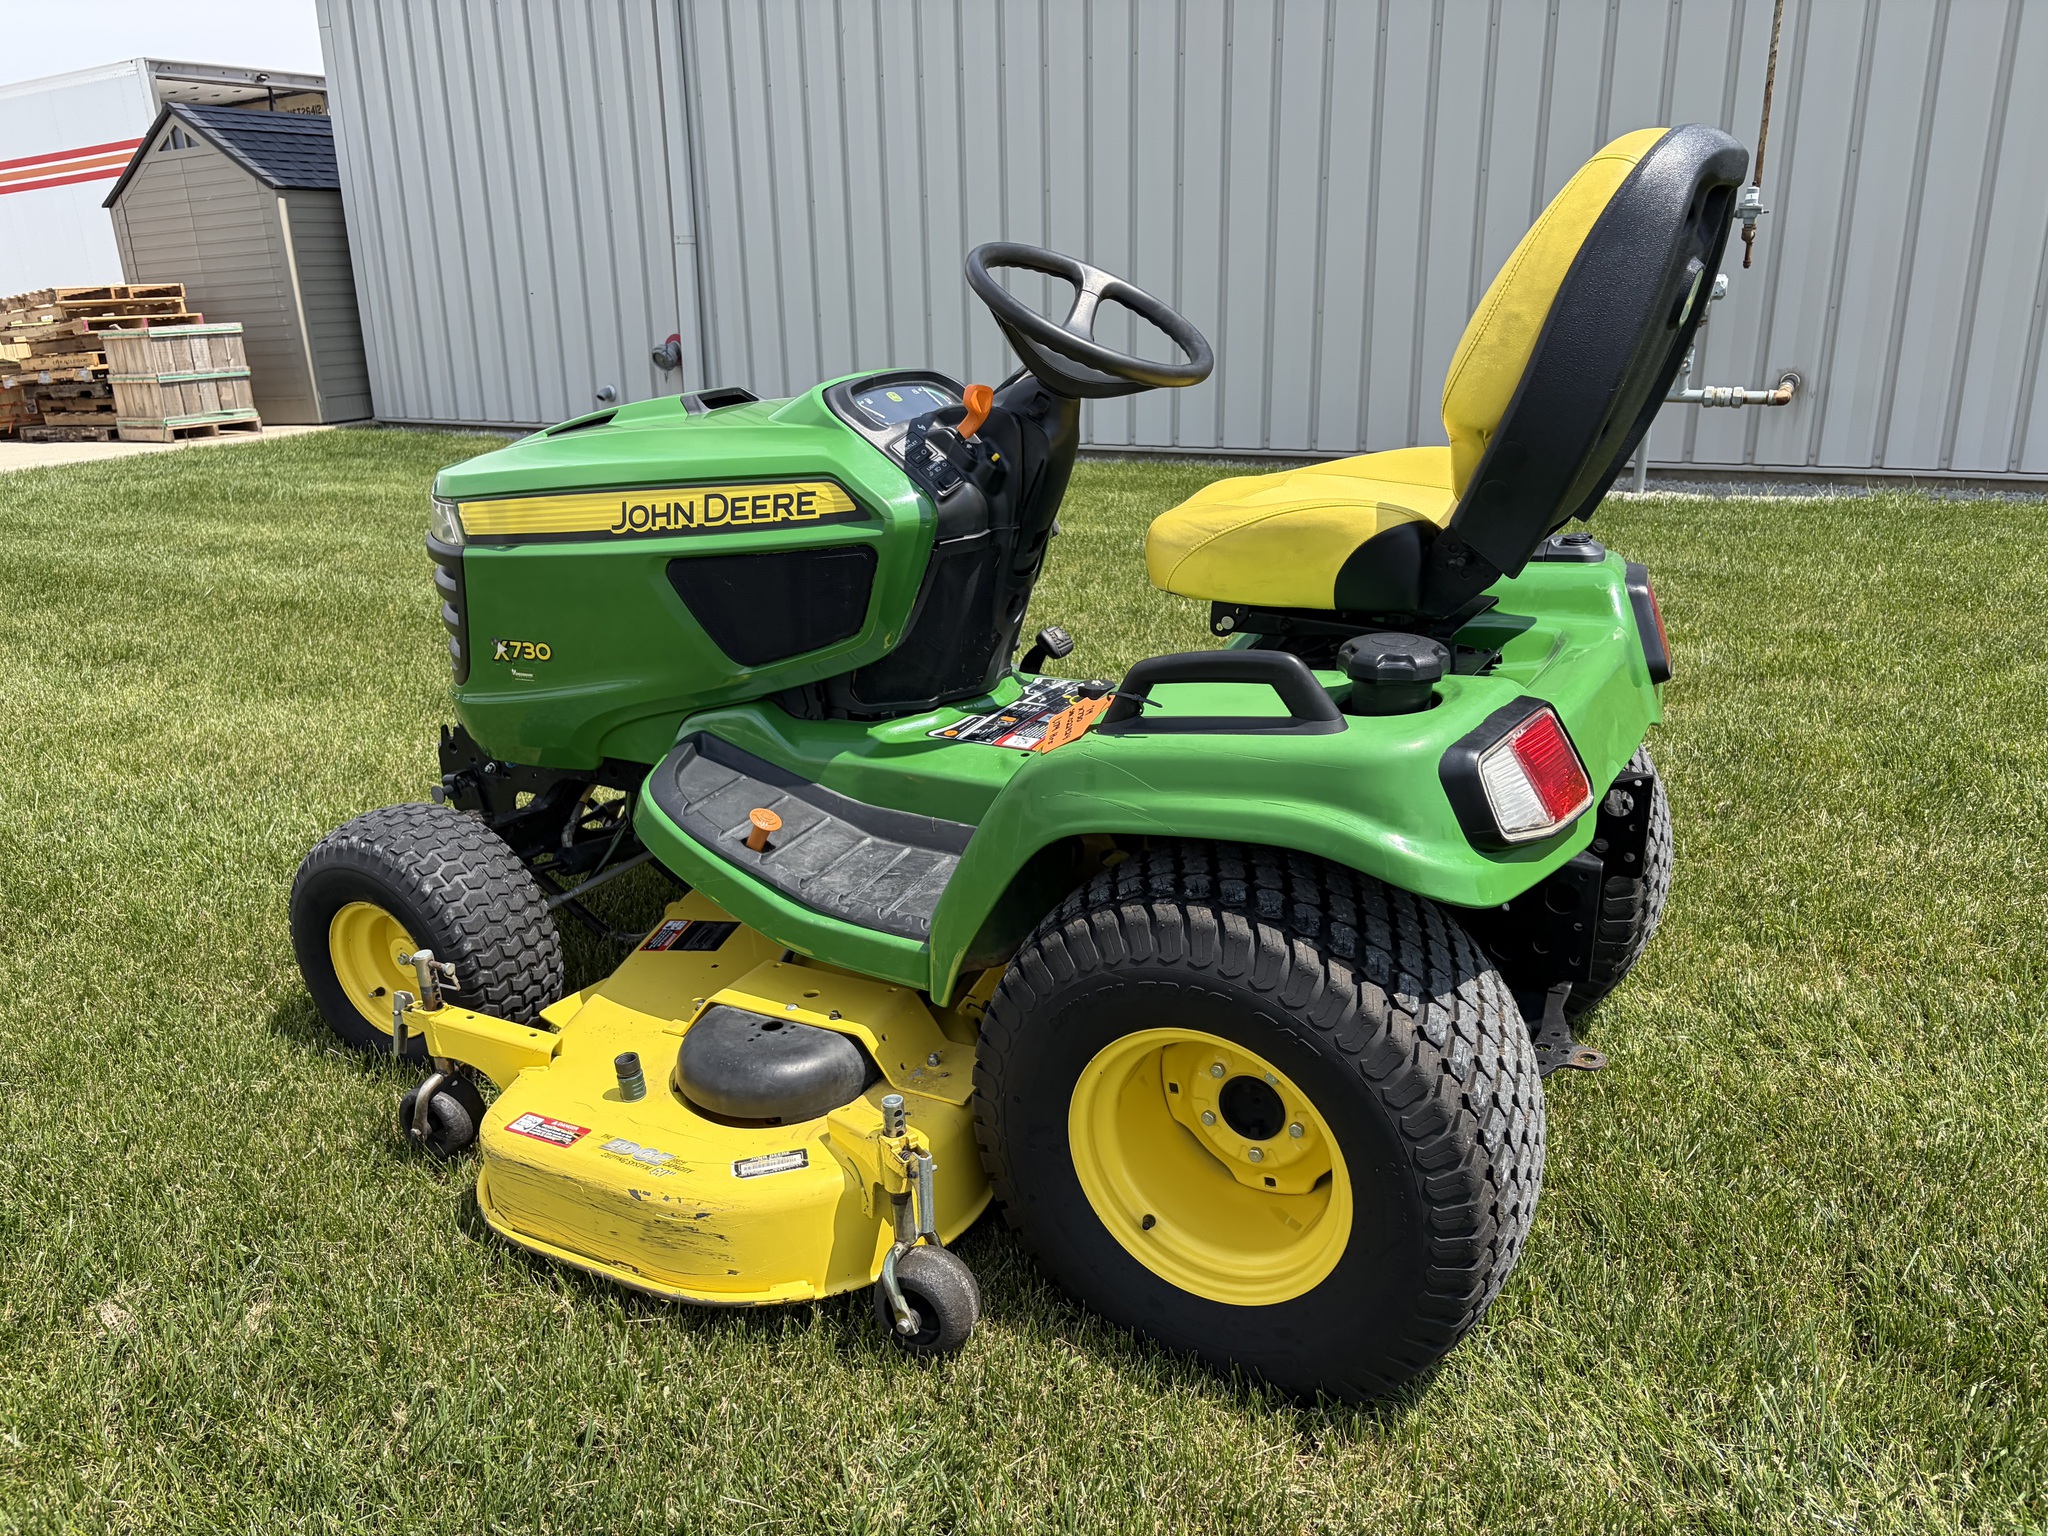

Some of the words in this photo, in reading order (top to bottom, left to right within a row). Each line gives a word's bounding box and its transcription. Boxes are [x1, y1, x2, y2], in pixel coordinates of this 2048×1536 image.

[611, 501, 694, 531] JOHN
[704, 491, 818, 523] DEERE
[493, 640, 552, 661] X730
[597, 1137, 676, 1167] EDGE
[600, 1152, 628, 1164] CUTTING
[626, 1158, 653, 1170] SYSTEM
[662, 1161, 695, 1173] CAPACITY
